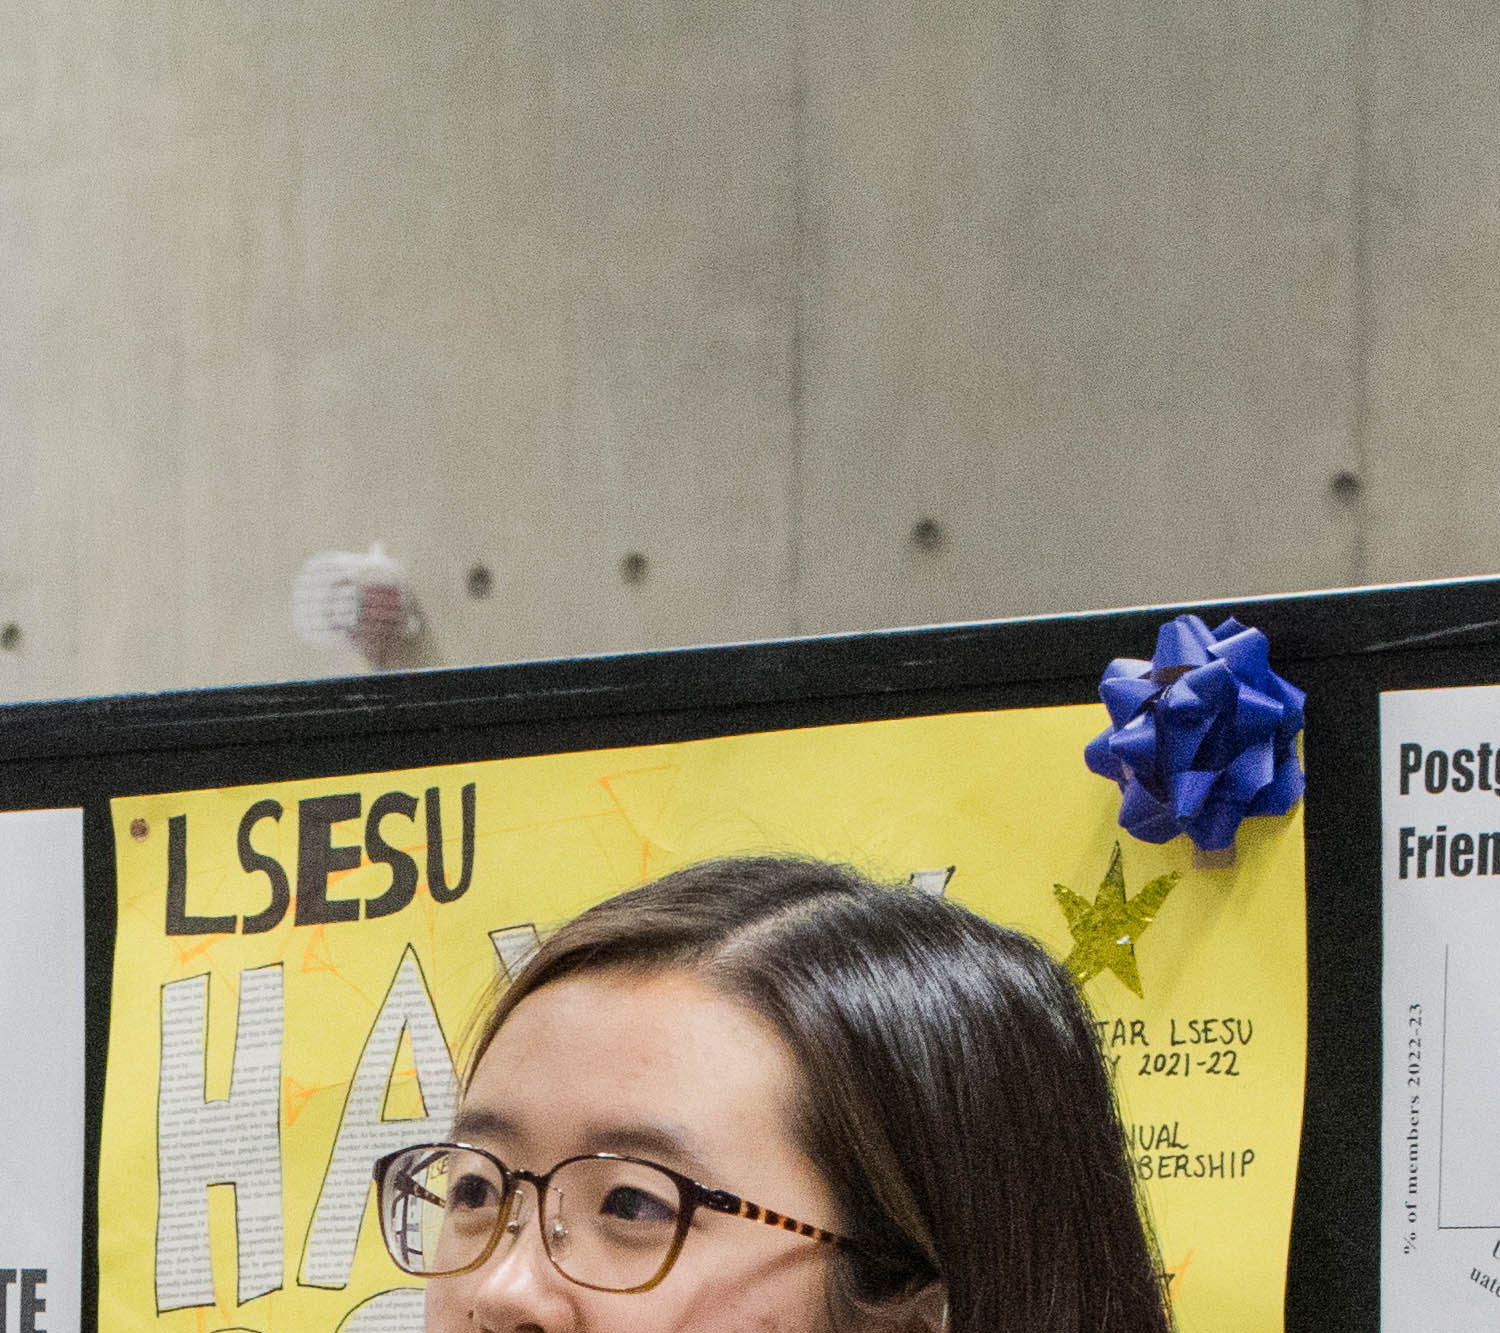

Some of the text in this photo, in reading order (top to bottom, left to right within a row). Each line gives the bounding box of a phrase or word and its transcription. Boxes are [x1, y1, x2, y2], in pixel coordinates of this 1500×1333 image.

[166, 783, 476, 936] LSESU
[1095, 1018, 1253, 1047] TAR LSESU
[1407, 1002, 1422, 1086] 2022-23
[1138, 1050, 1240, 1077] 2021-22
[155, 923, 545, 1317] HA
[1406, 1095, 1420, 1195] members
[1137, 1149, 1255, 1181] BERSHIP
[1405, 1200, 1417, 1223] of
